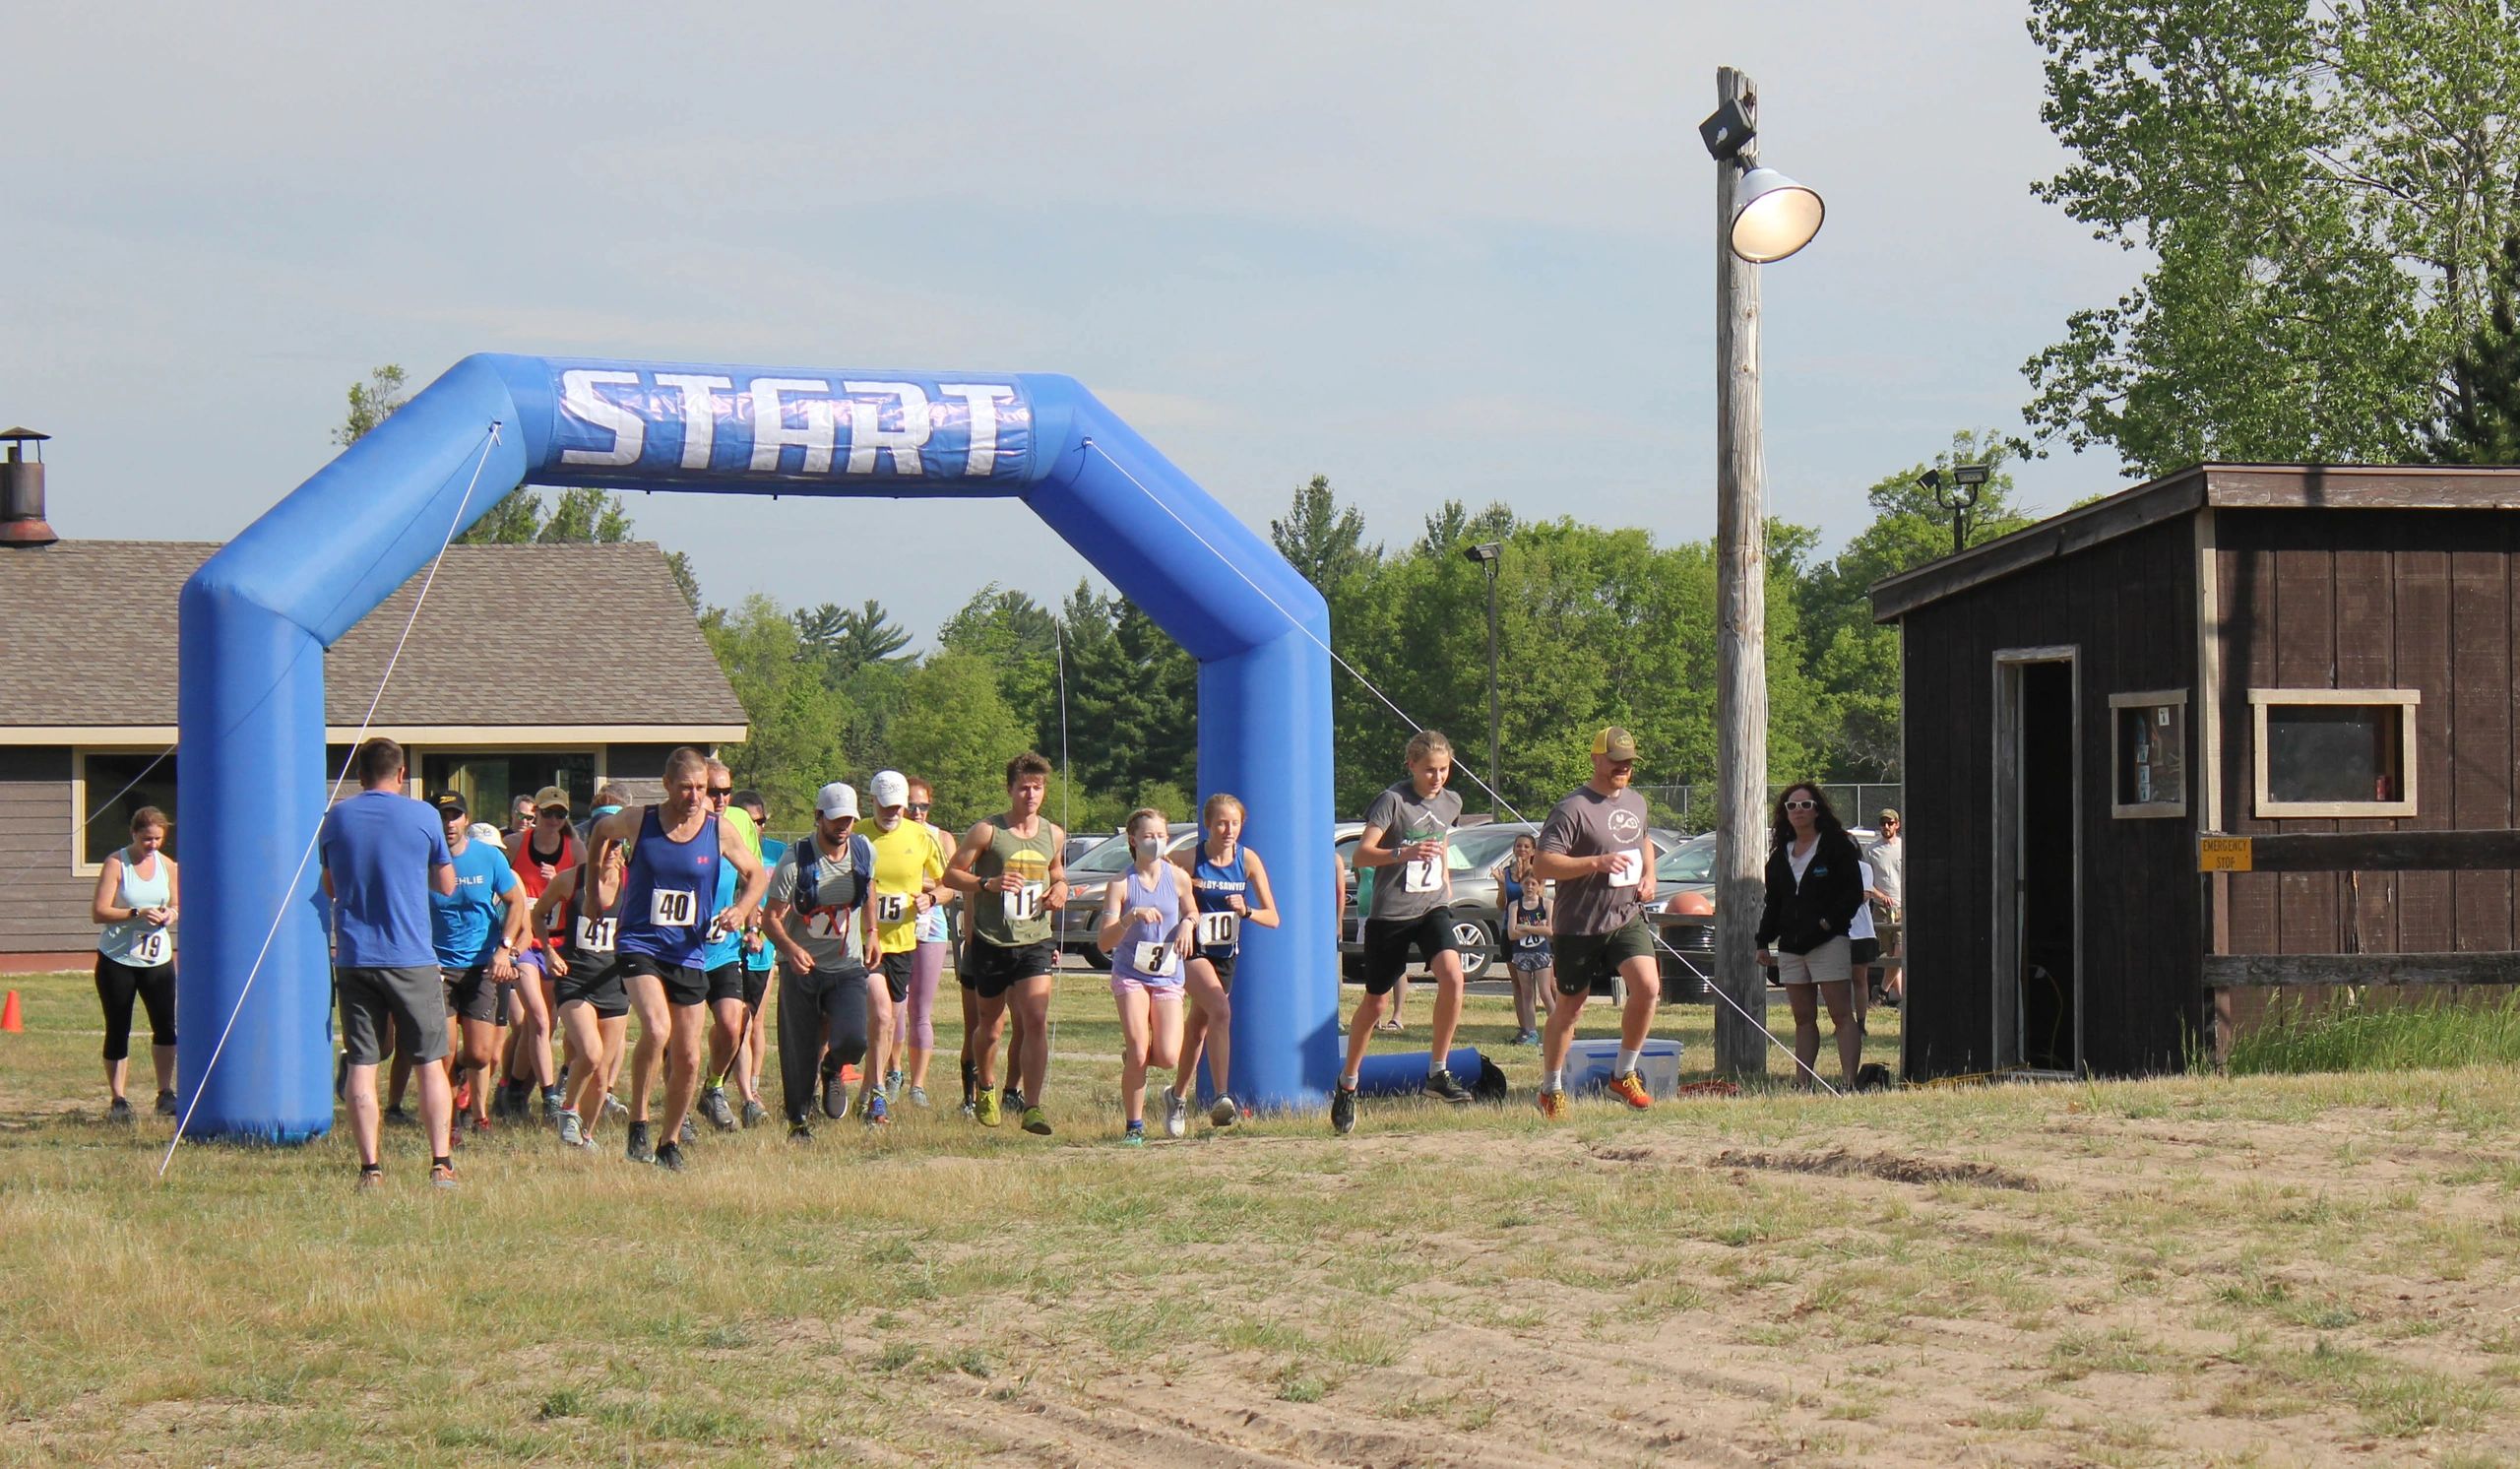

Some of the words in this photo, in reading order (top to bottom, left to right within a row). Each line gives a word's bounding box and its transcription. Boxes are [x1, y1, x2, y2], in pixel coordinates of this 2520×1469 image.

[559, 369, 1014, 476] START
[2203, 840, 2246, 852] EMERGENCY
[1420, 861, 1432, 887] 2
[2216, 857, 2236, 868] STOP
[660, 893, 689, 922] 40
[878, 896, 901, 921] 15
[1015, 889, 1034, 917] 11
[584, 920, 609, 946] 41
[1209, 915, 1232, 941] 10
[141, 933, 161, 958] 19
[1148, 946, 1164, 972] 3
